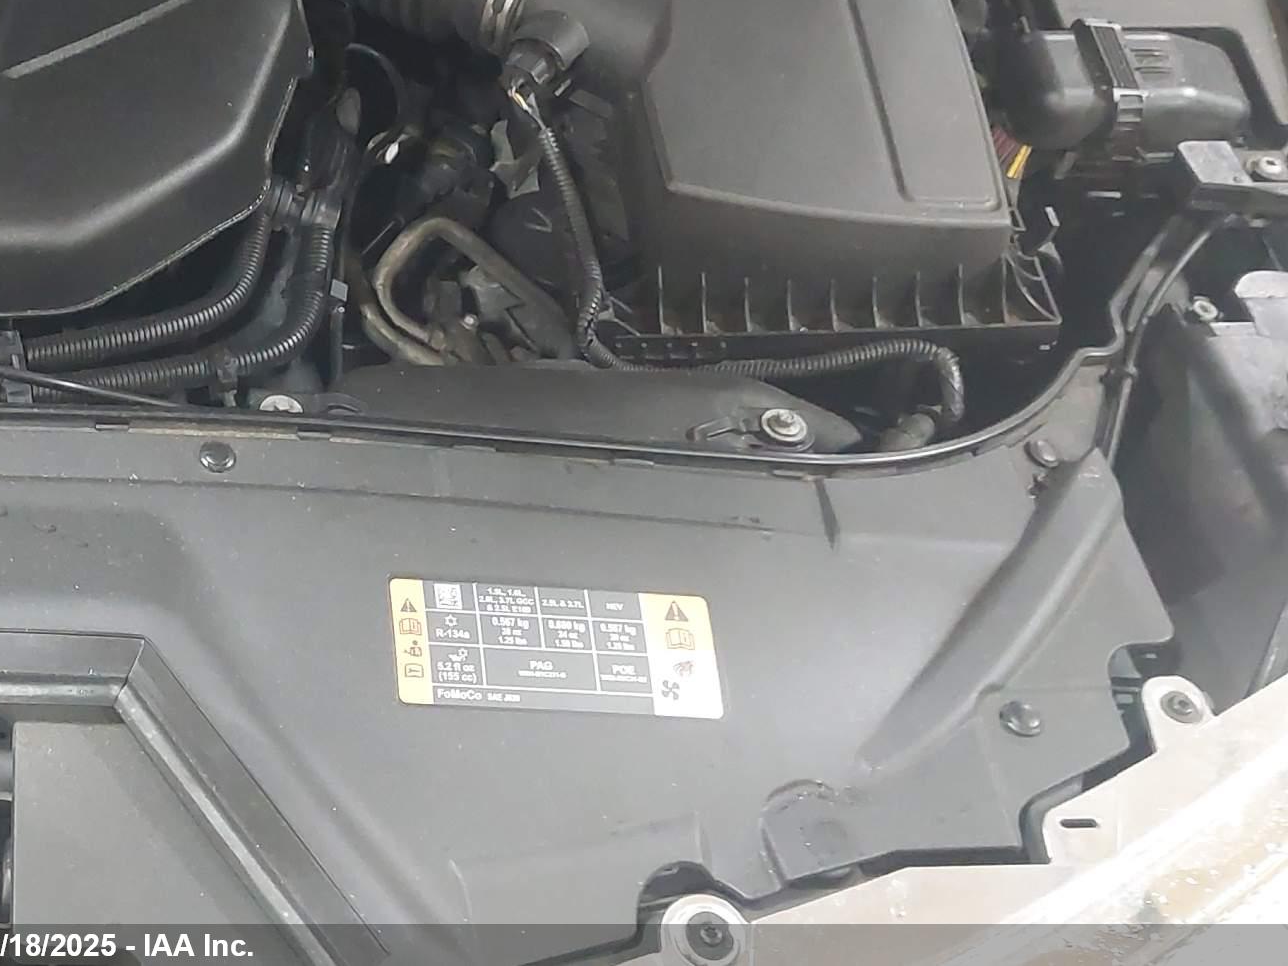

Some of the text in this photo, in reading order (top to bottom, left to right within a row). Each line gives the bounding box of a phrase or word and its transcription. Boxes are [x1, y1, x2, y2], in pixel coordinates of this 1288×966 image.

[516, 617, 529, 629] kg
[573, 620, 586, 633] kg
[435, 628, 470, 639] R-134a
[437, 661, 475, 672] 5.2 fl oz
[529, 660, 553, 671] PAG
[611, 664, 636, 675] POE
[438, 671, 477, 684] (155 cc)
[437, 688, 483, 700] FoMoCo
